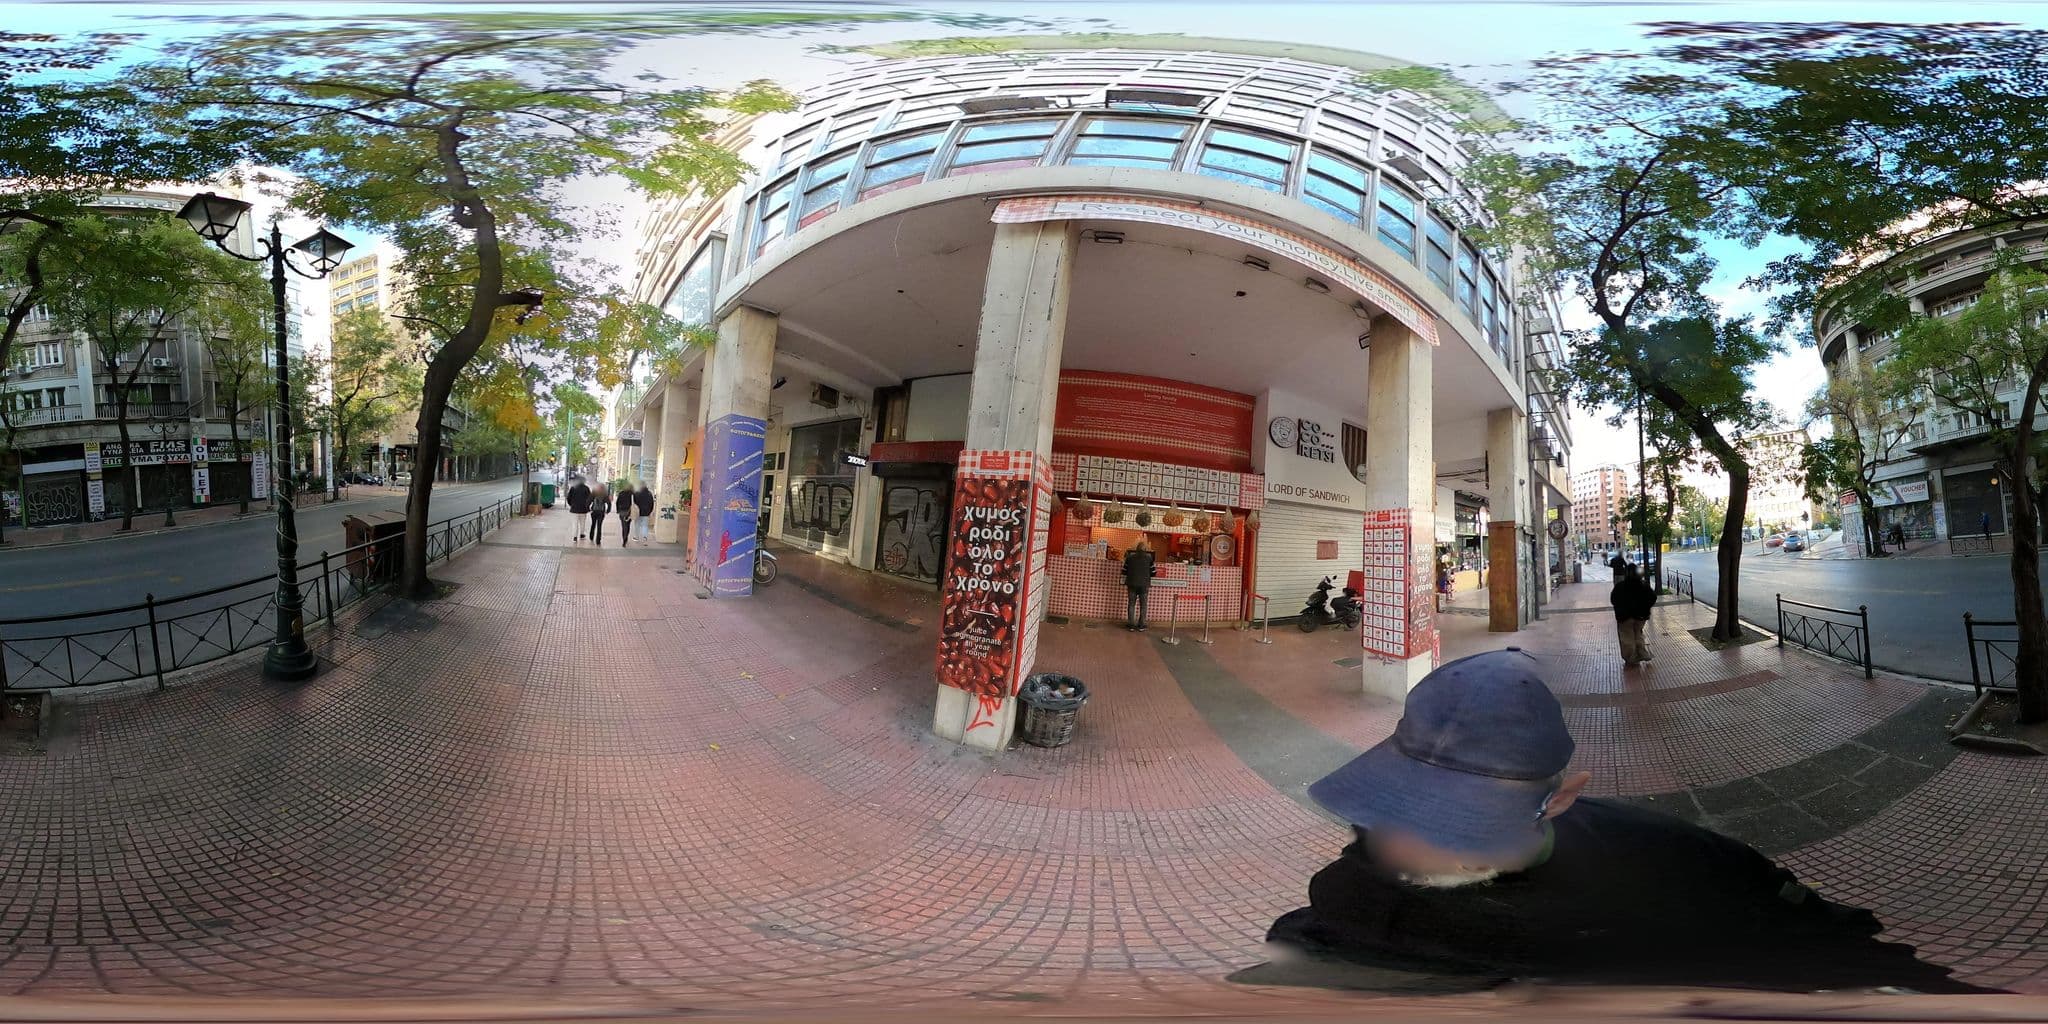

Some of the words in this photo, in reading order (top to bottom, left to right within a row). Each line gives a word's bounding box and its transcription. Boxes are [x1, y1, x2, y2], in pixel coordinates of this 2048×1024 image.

[1081, 203, 1204, 224] Respect
[1212, 219, 1267, 240] your
[1378, 289, 1411, 317] smart
[1268, 482, 1294, 495] LORD
[1295, 486, 1308, 497] OF
[1309, 489, 1350, 504] SANDWICH
[963, 505, 1020, 525] χυμός
[969, 524, 1010, 542] ρόδι
[971, 542, 1005, 561] όλο
[973, 562, 993, 576] το
[956, 575, 1014, 594] χρόνο
[974, 644, 990, 652] year
